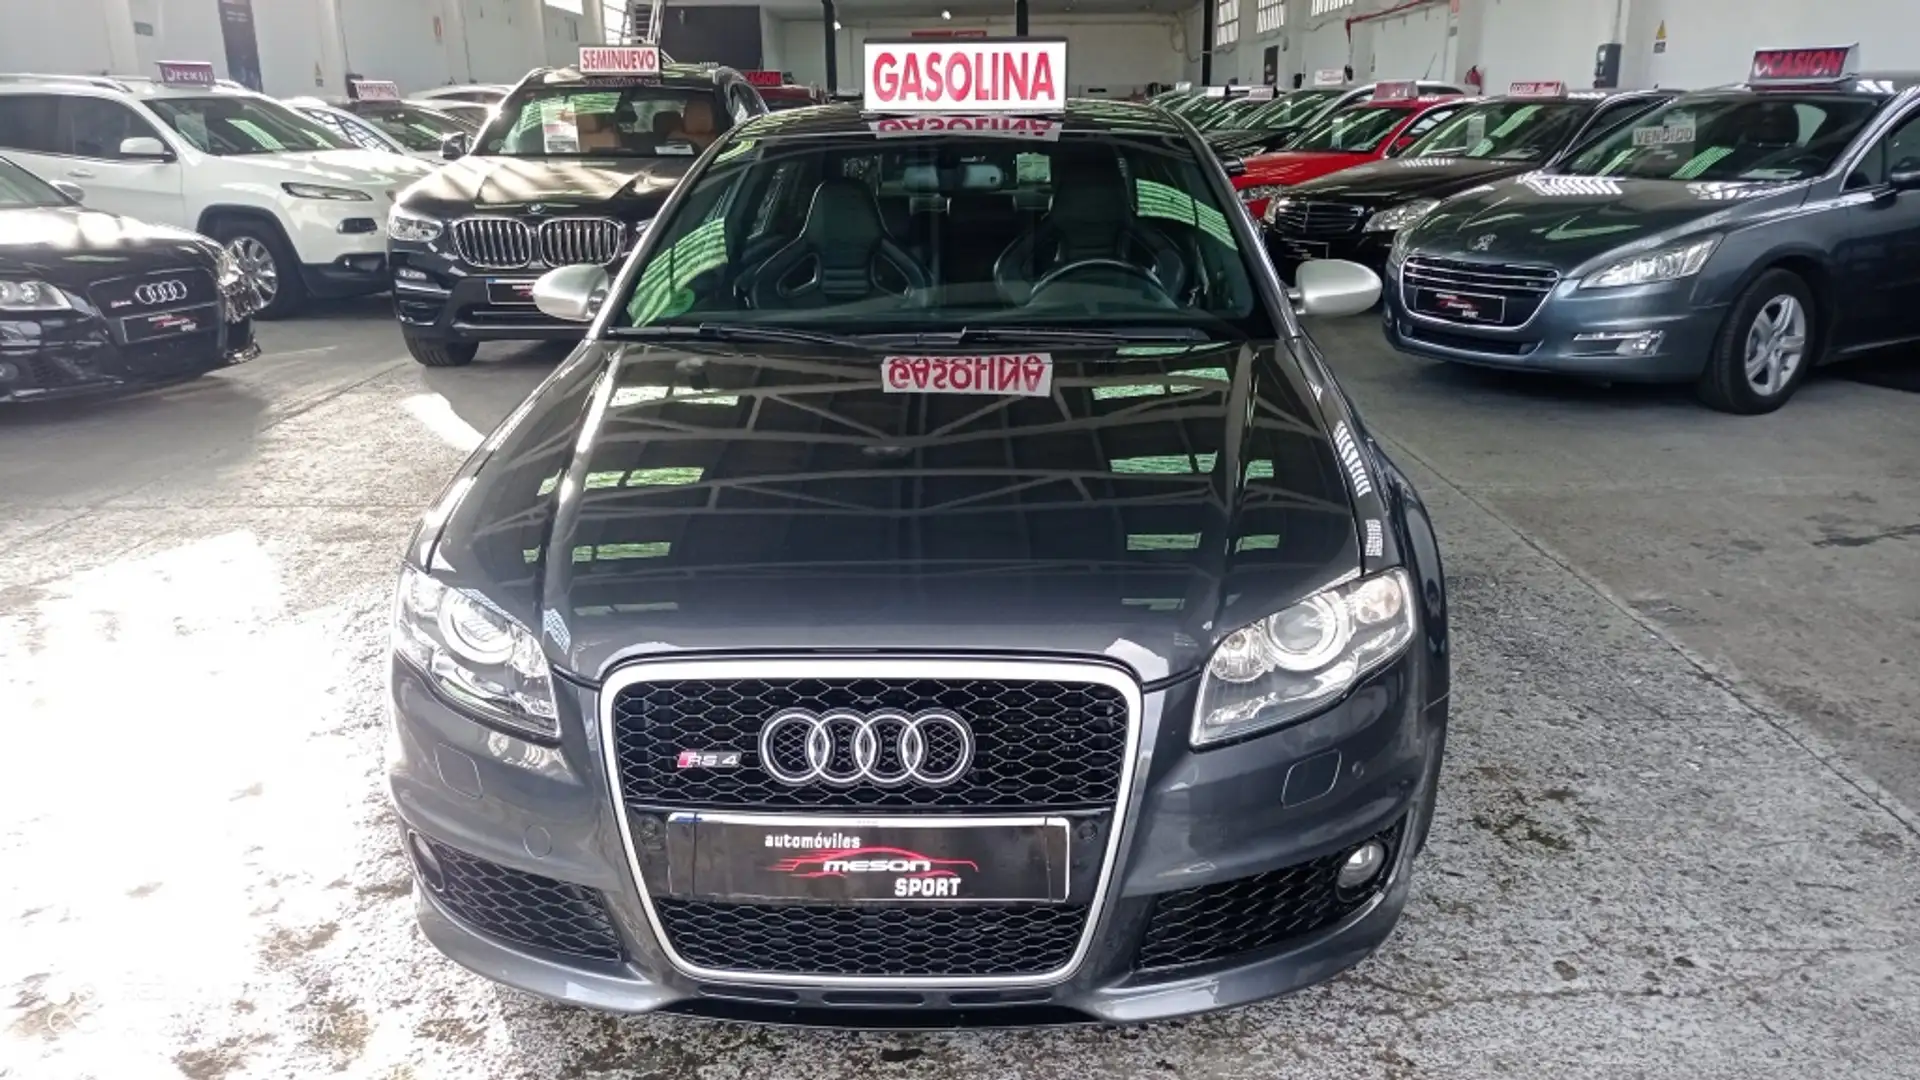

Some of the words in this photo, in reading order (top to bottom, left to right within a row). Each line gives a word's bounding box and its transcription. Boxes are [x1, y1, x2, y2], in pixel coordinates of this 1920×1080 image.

[583, 50, 656, 69] SEMINUEVO
[873, 51, 1056, 102] GASOLINA
[1637, 127, 1692, 145] VENDIDO
[764, 832, 861, 849] automóviles
[822, 859, 932, 872] meson
[894, 877, 962, 897] SPORT
